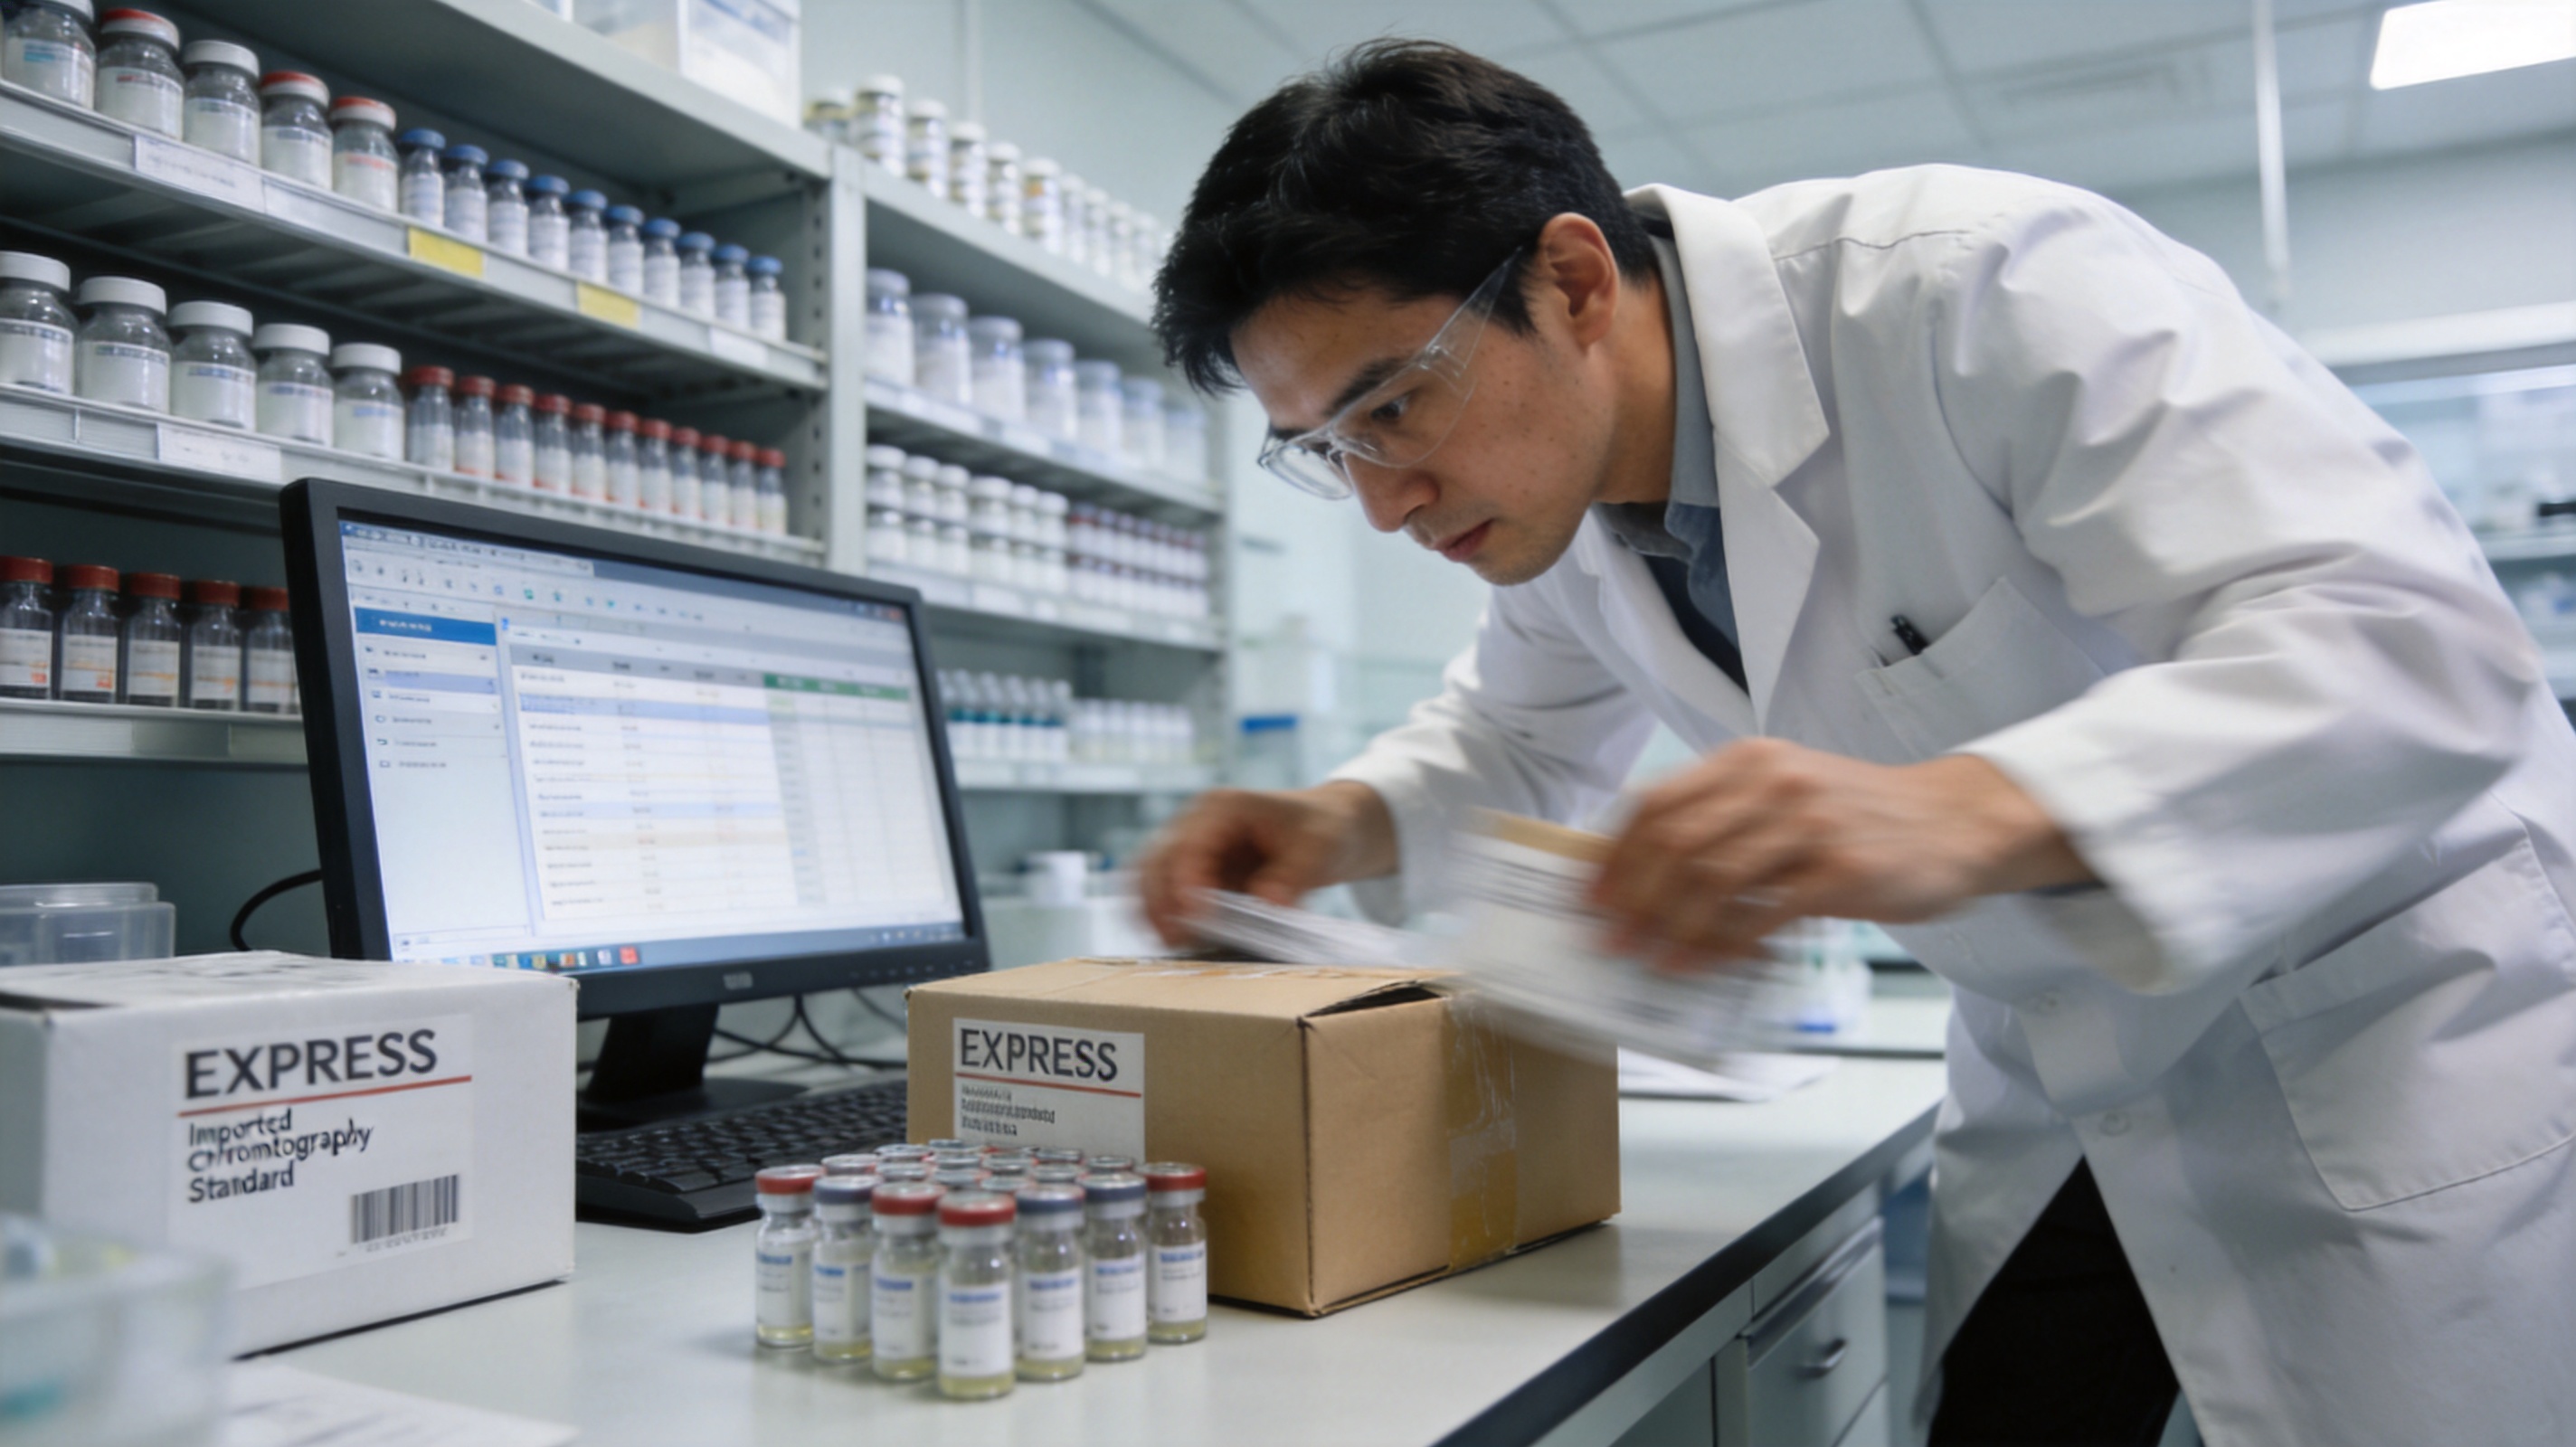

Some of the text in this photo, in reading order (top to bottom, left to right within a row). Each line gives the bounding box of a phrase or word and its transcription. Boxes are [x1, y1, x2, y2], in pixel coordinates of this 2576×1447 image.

[185, 1028, 438, 1100] EXPRESS
[960, 1027, 1118, 1083] EXPRESS
[189, 1106, 292, 1149] Imported
[188, 1159, 295, 1204] Standard
